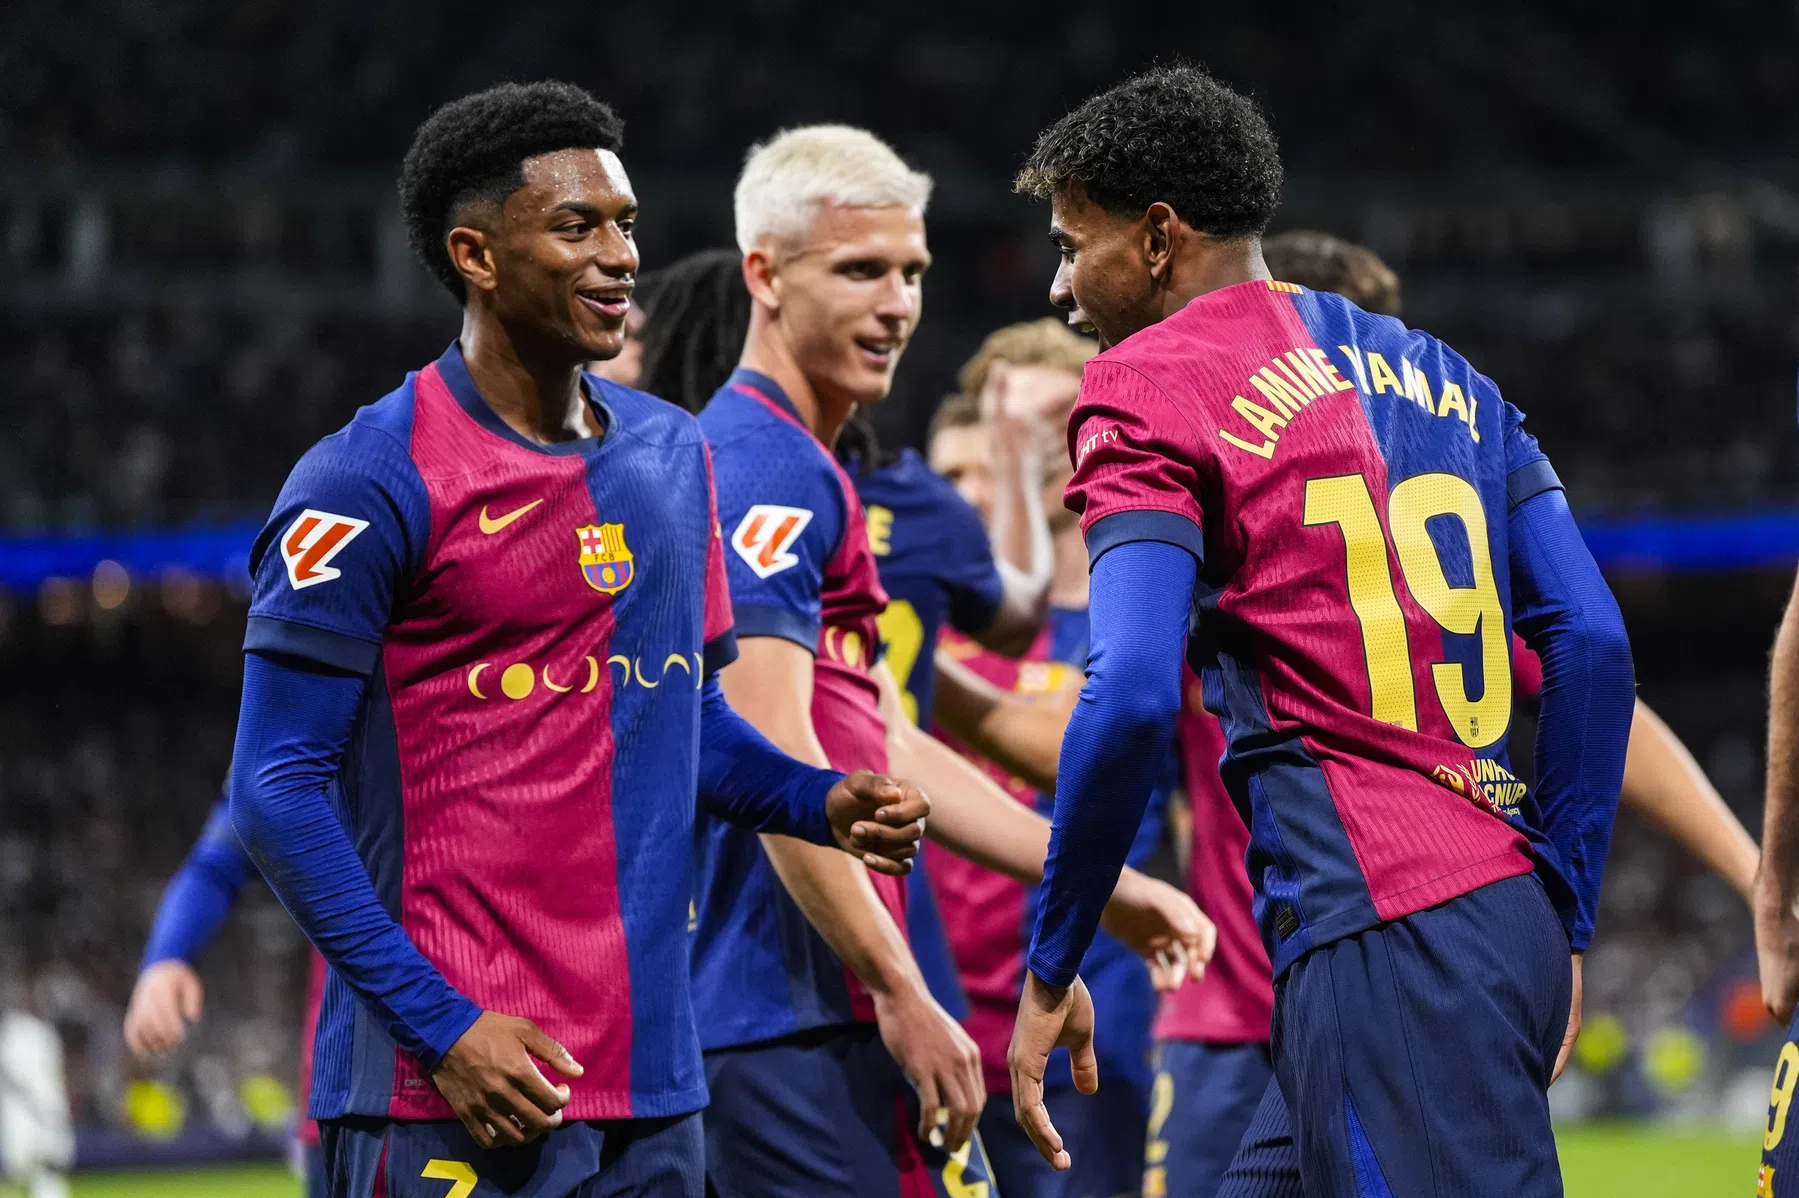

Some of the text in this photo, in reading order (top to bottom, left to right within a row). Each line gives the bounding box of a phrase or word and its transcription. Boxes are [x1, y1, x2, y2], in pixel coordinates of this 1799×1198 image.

[1101, 429, 1119, 443] tv
[1218, 343, 1481, 460] LAMINE YAMAL
[1302, 471, 1513, 750] 19
